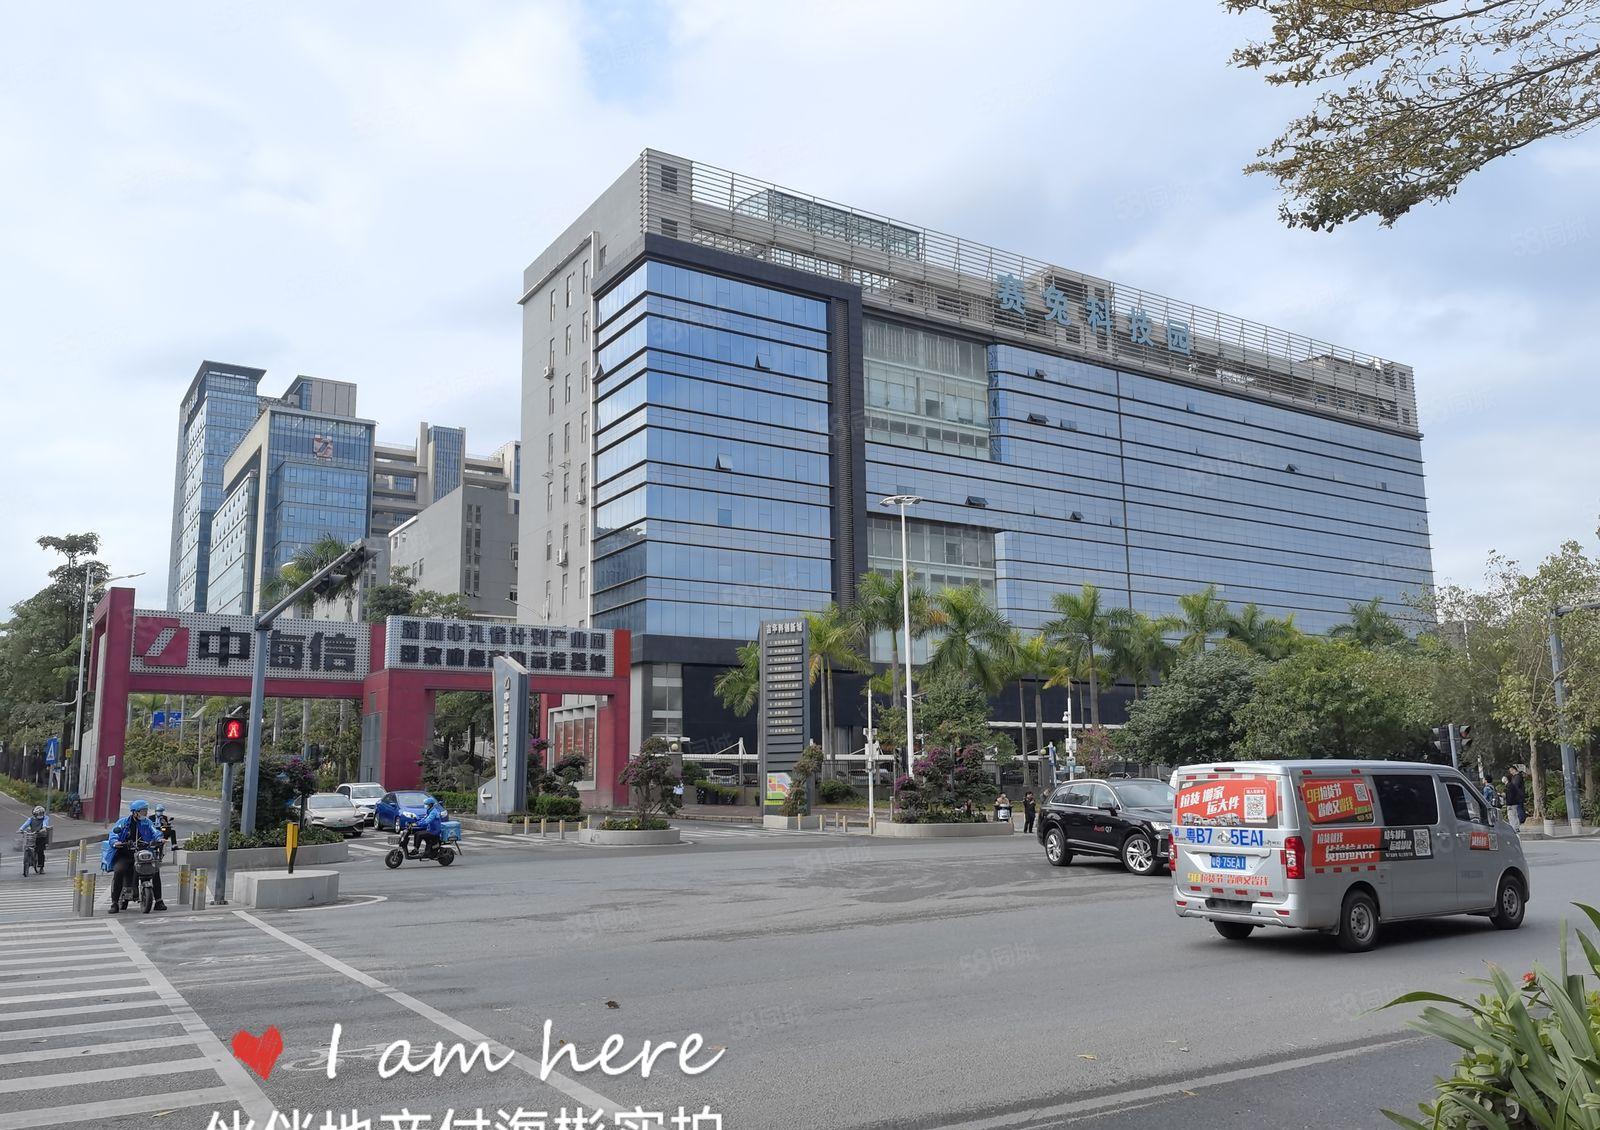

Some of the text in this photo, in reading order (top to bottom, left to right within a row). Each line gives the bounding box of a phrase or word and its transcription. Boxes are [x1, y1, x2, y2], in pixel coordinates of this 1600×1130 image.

[1180, 790, 1201, 809] 拉货
[1206, 795, 1240, 816] 运大件
[1186, 827, 1213, 844] 粤B7
[1230, 829, 1264, 847] 5EA1
